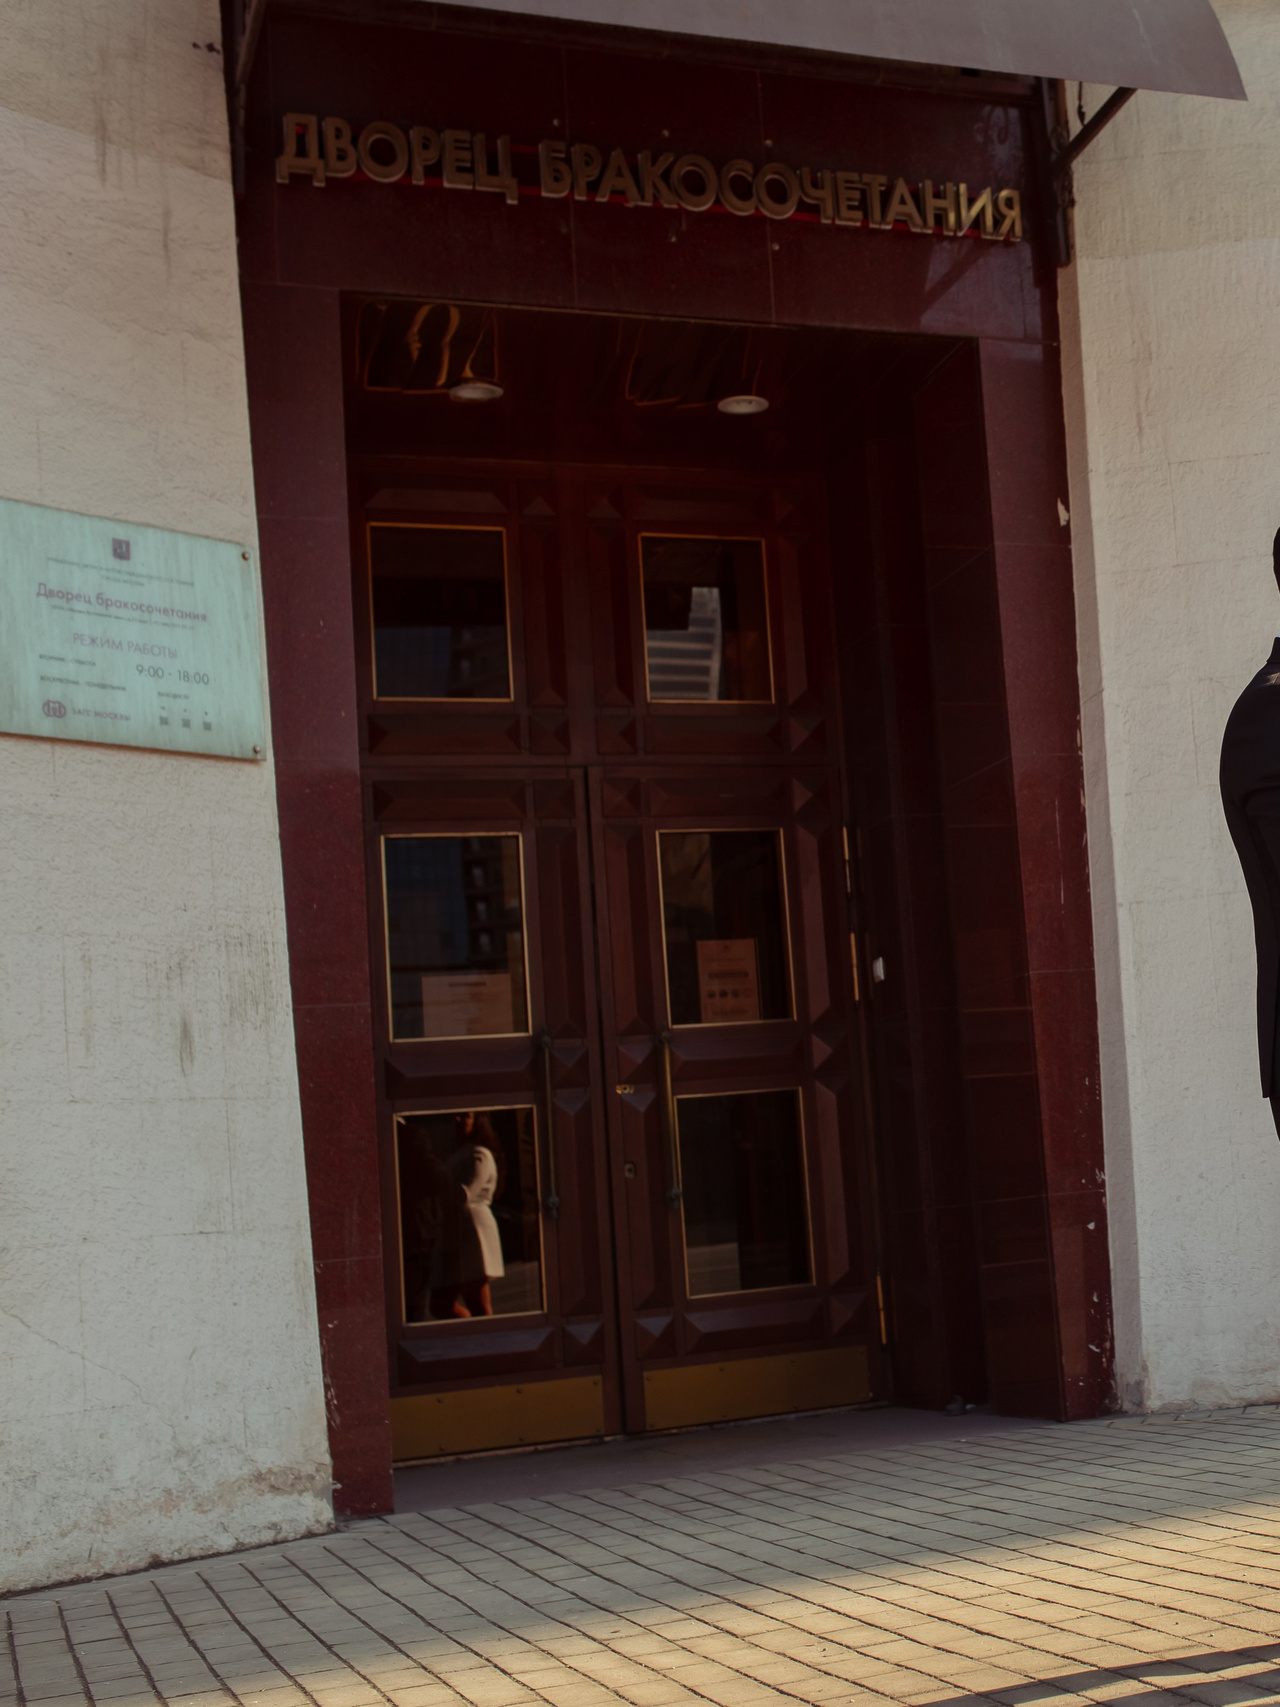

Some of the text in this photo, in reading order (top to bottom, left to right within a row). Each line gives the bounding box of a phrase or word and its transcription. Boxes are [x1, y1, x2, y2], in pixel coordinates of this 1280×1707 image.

[275, 111, 1024, 242] ДВОРЕЦ БРАКОСОЧЕТАНИЯ
[36, 582, 92, 606] Дворец
[95, 592, 207, 622] бракосочетания
[73, 632, 178, 659] РЕЖИМ РАБОТЫ
[136, 663, 164, 679] 9:00
[177, 669, 210, 685] 18:00
